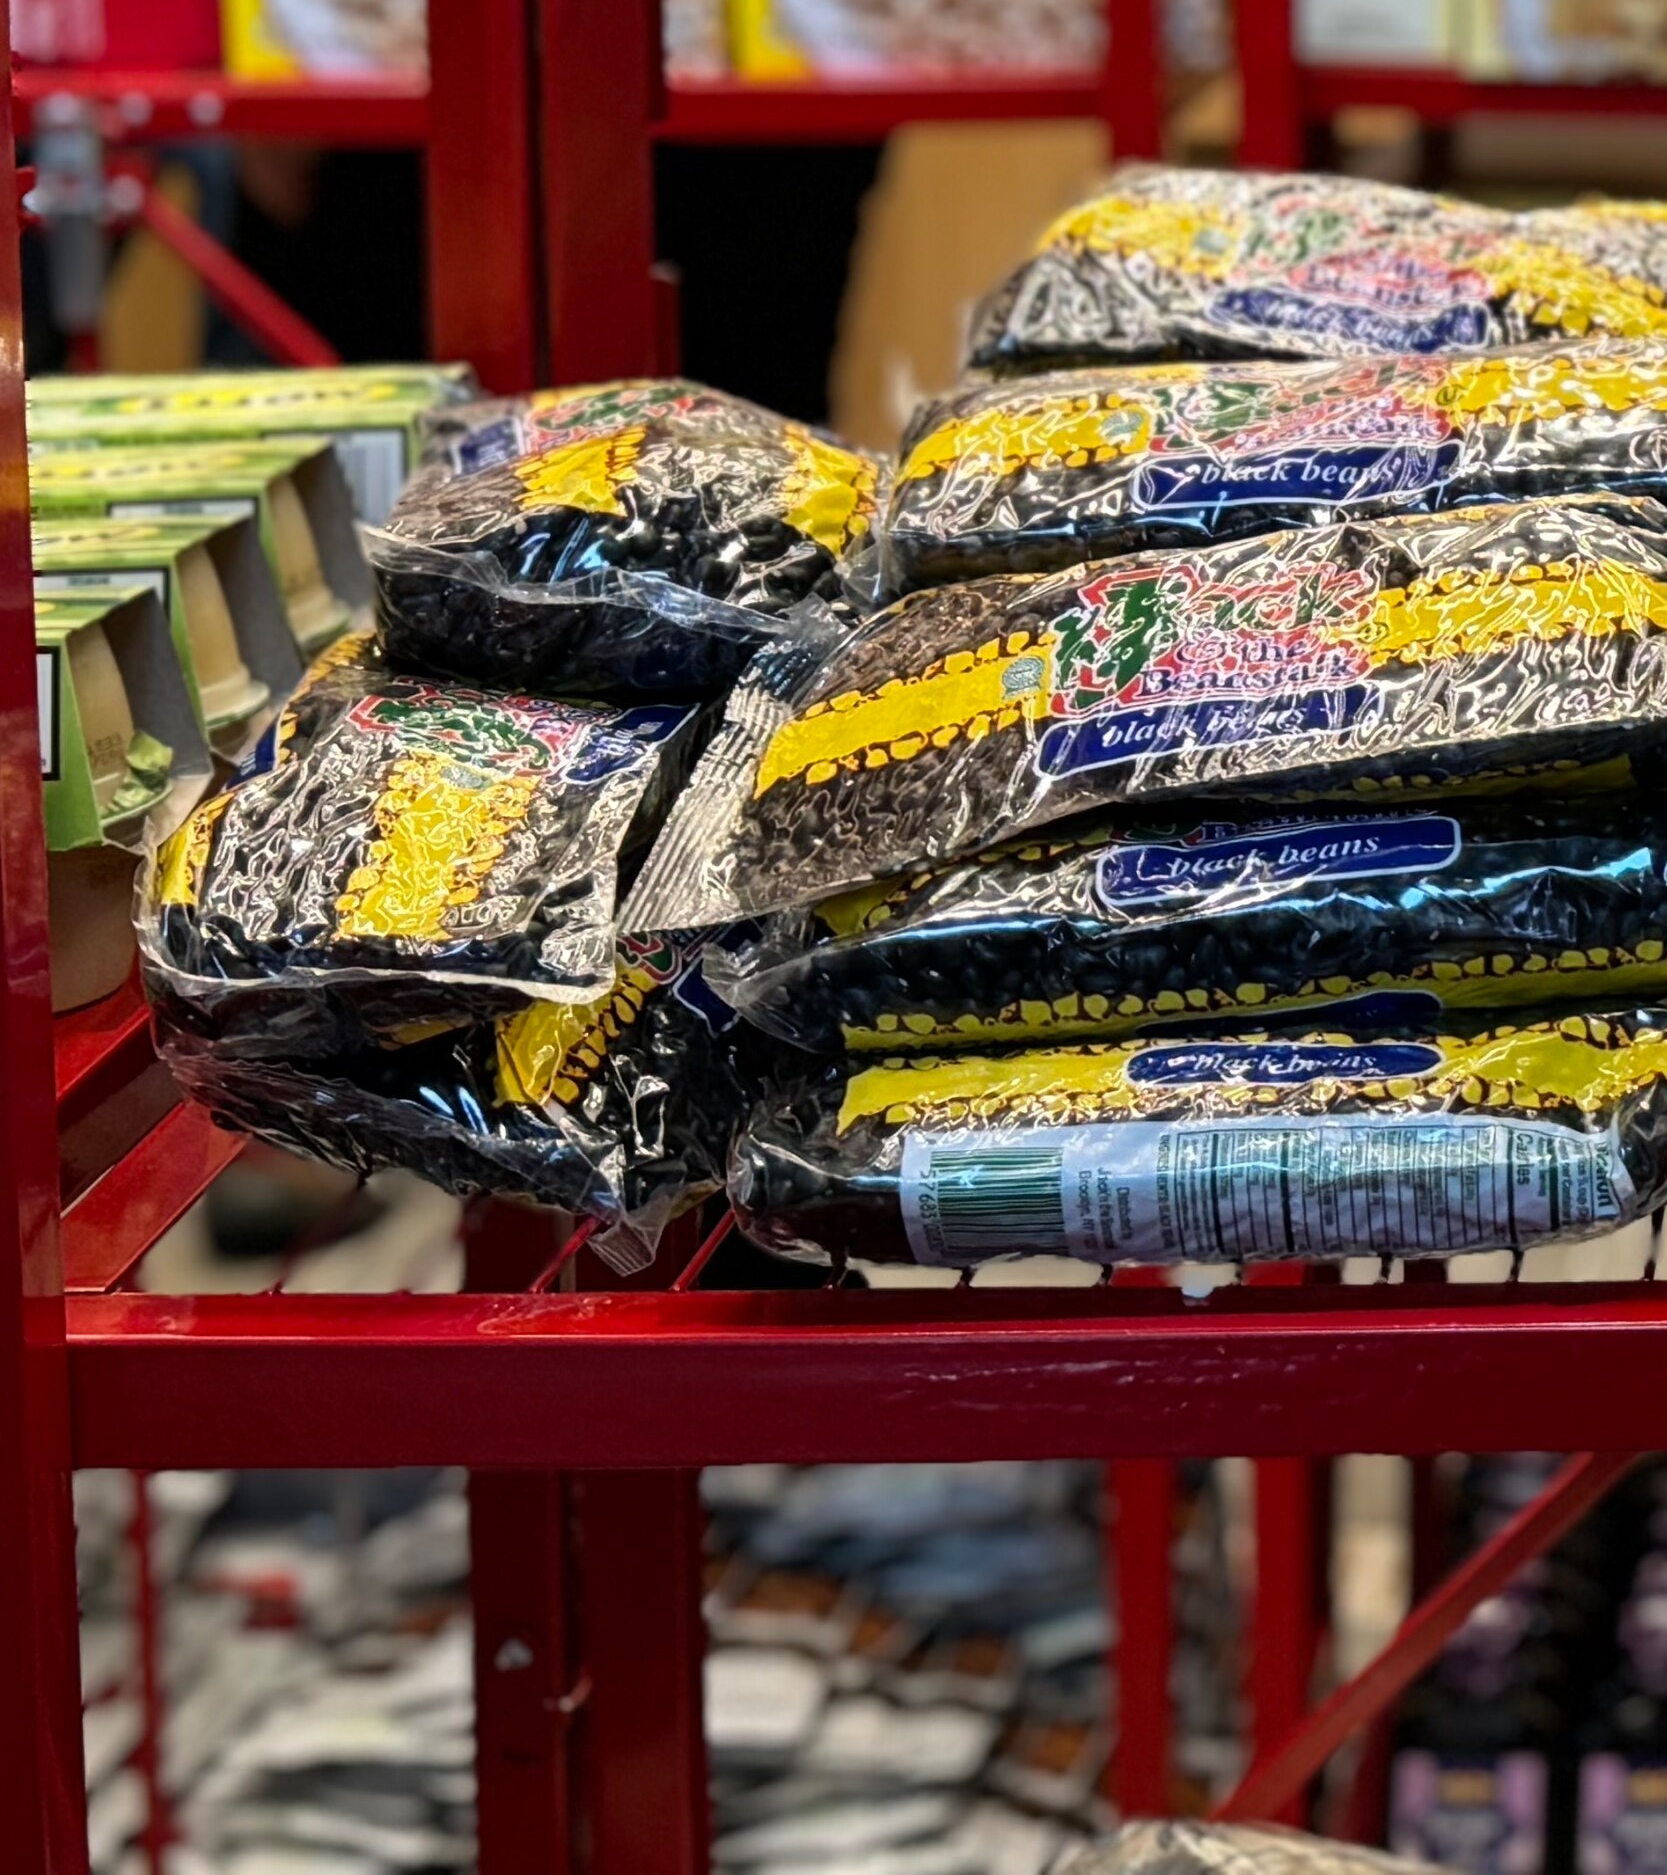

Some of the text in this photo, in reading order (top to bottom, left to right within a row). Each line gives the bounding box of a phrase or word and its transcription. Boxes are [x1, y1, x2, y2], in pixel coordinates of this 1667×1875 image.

[1200, 462, 1290, 485] black
[1168, 835, 1382, 879] black beans
